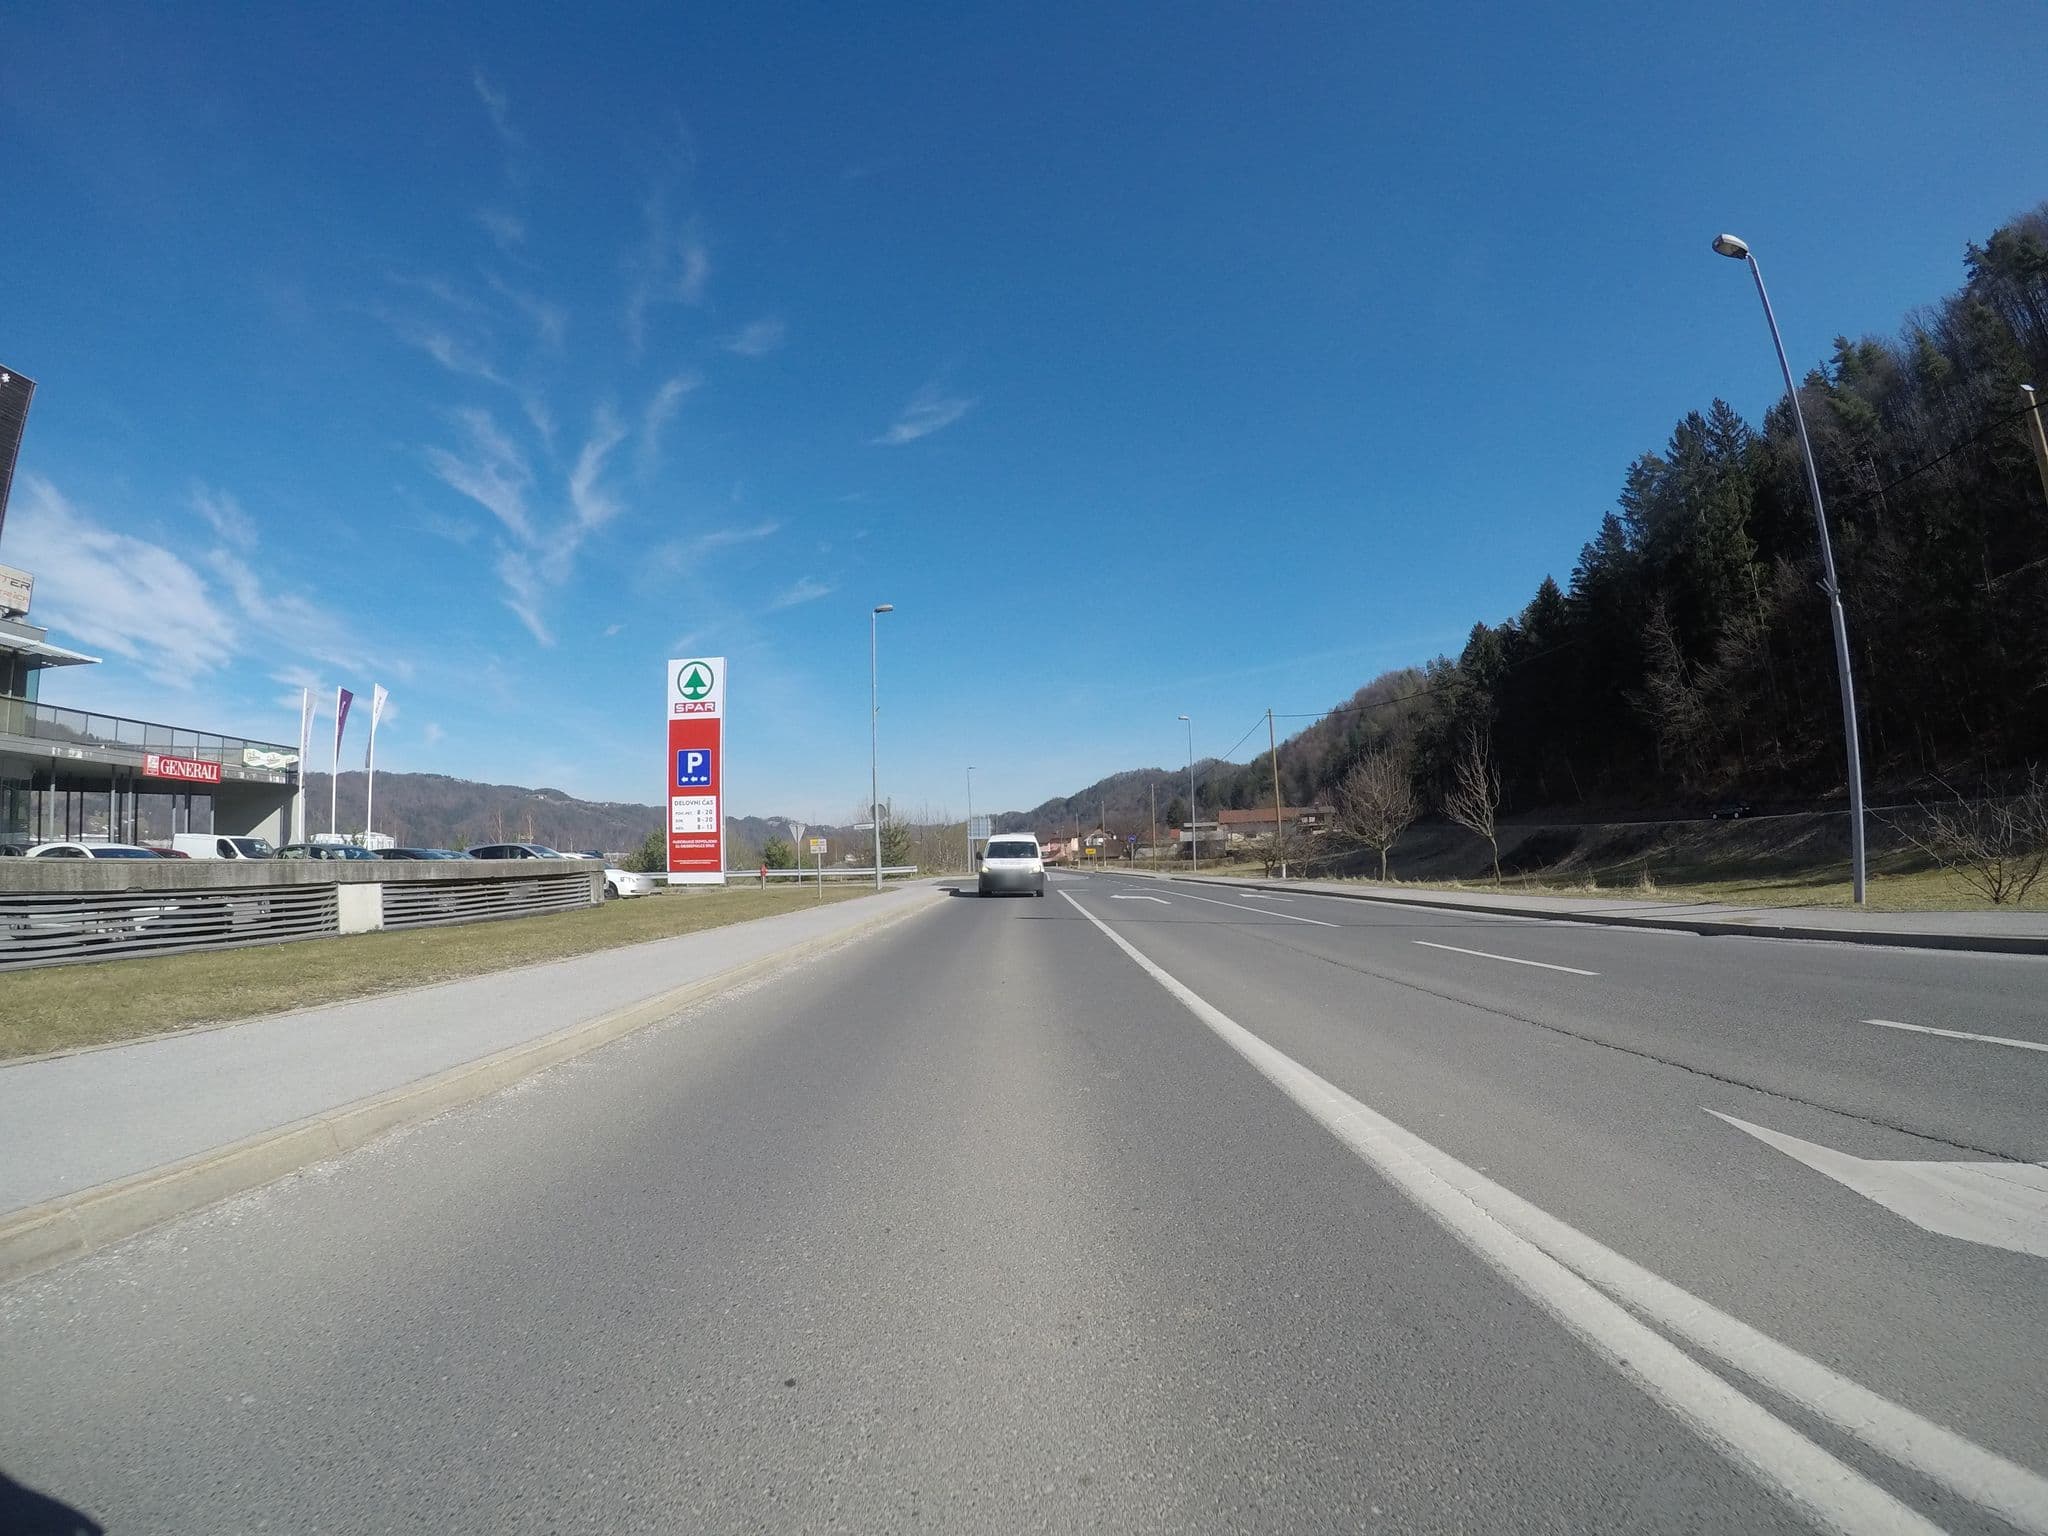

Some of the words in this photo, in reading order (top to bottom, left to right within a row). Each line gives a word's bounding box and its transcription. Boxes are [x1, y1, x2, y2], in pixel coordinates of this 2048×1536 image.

[675, 702, 714, 712] SPAR
[160, 759, 219, 780] GENERALI
[687, 752, 703, 774] P
